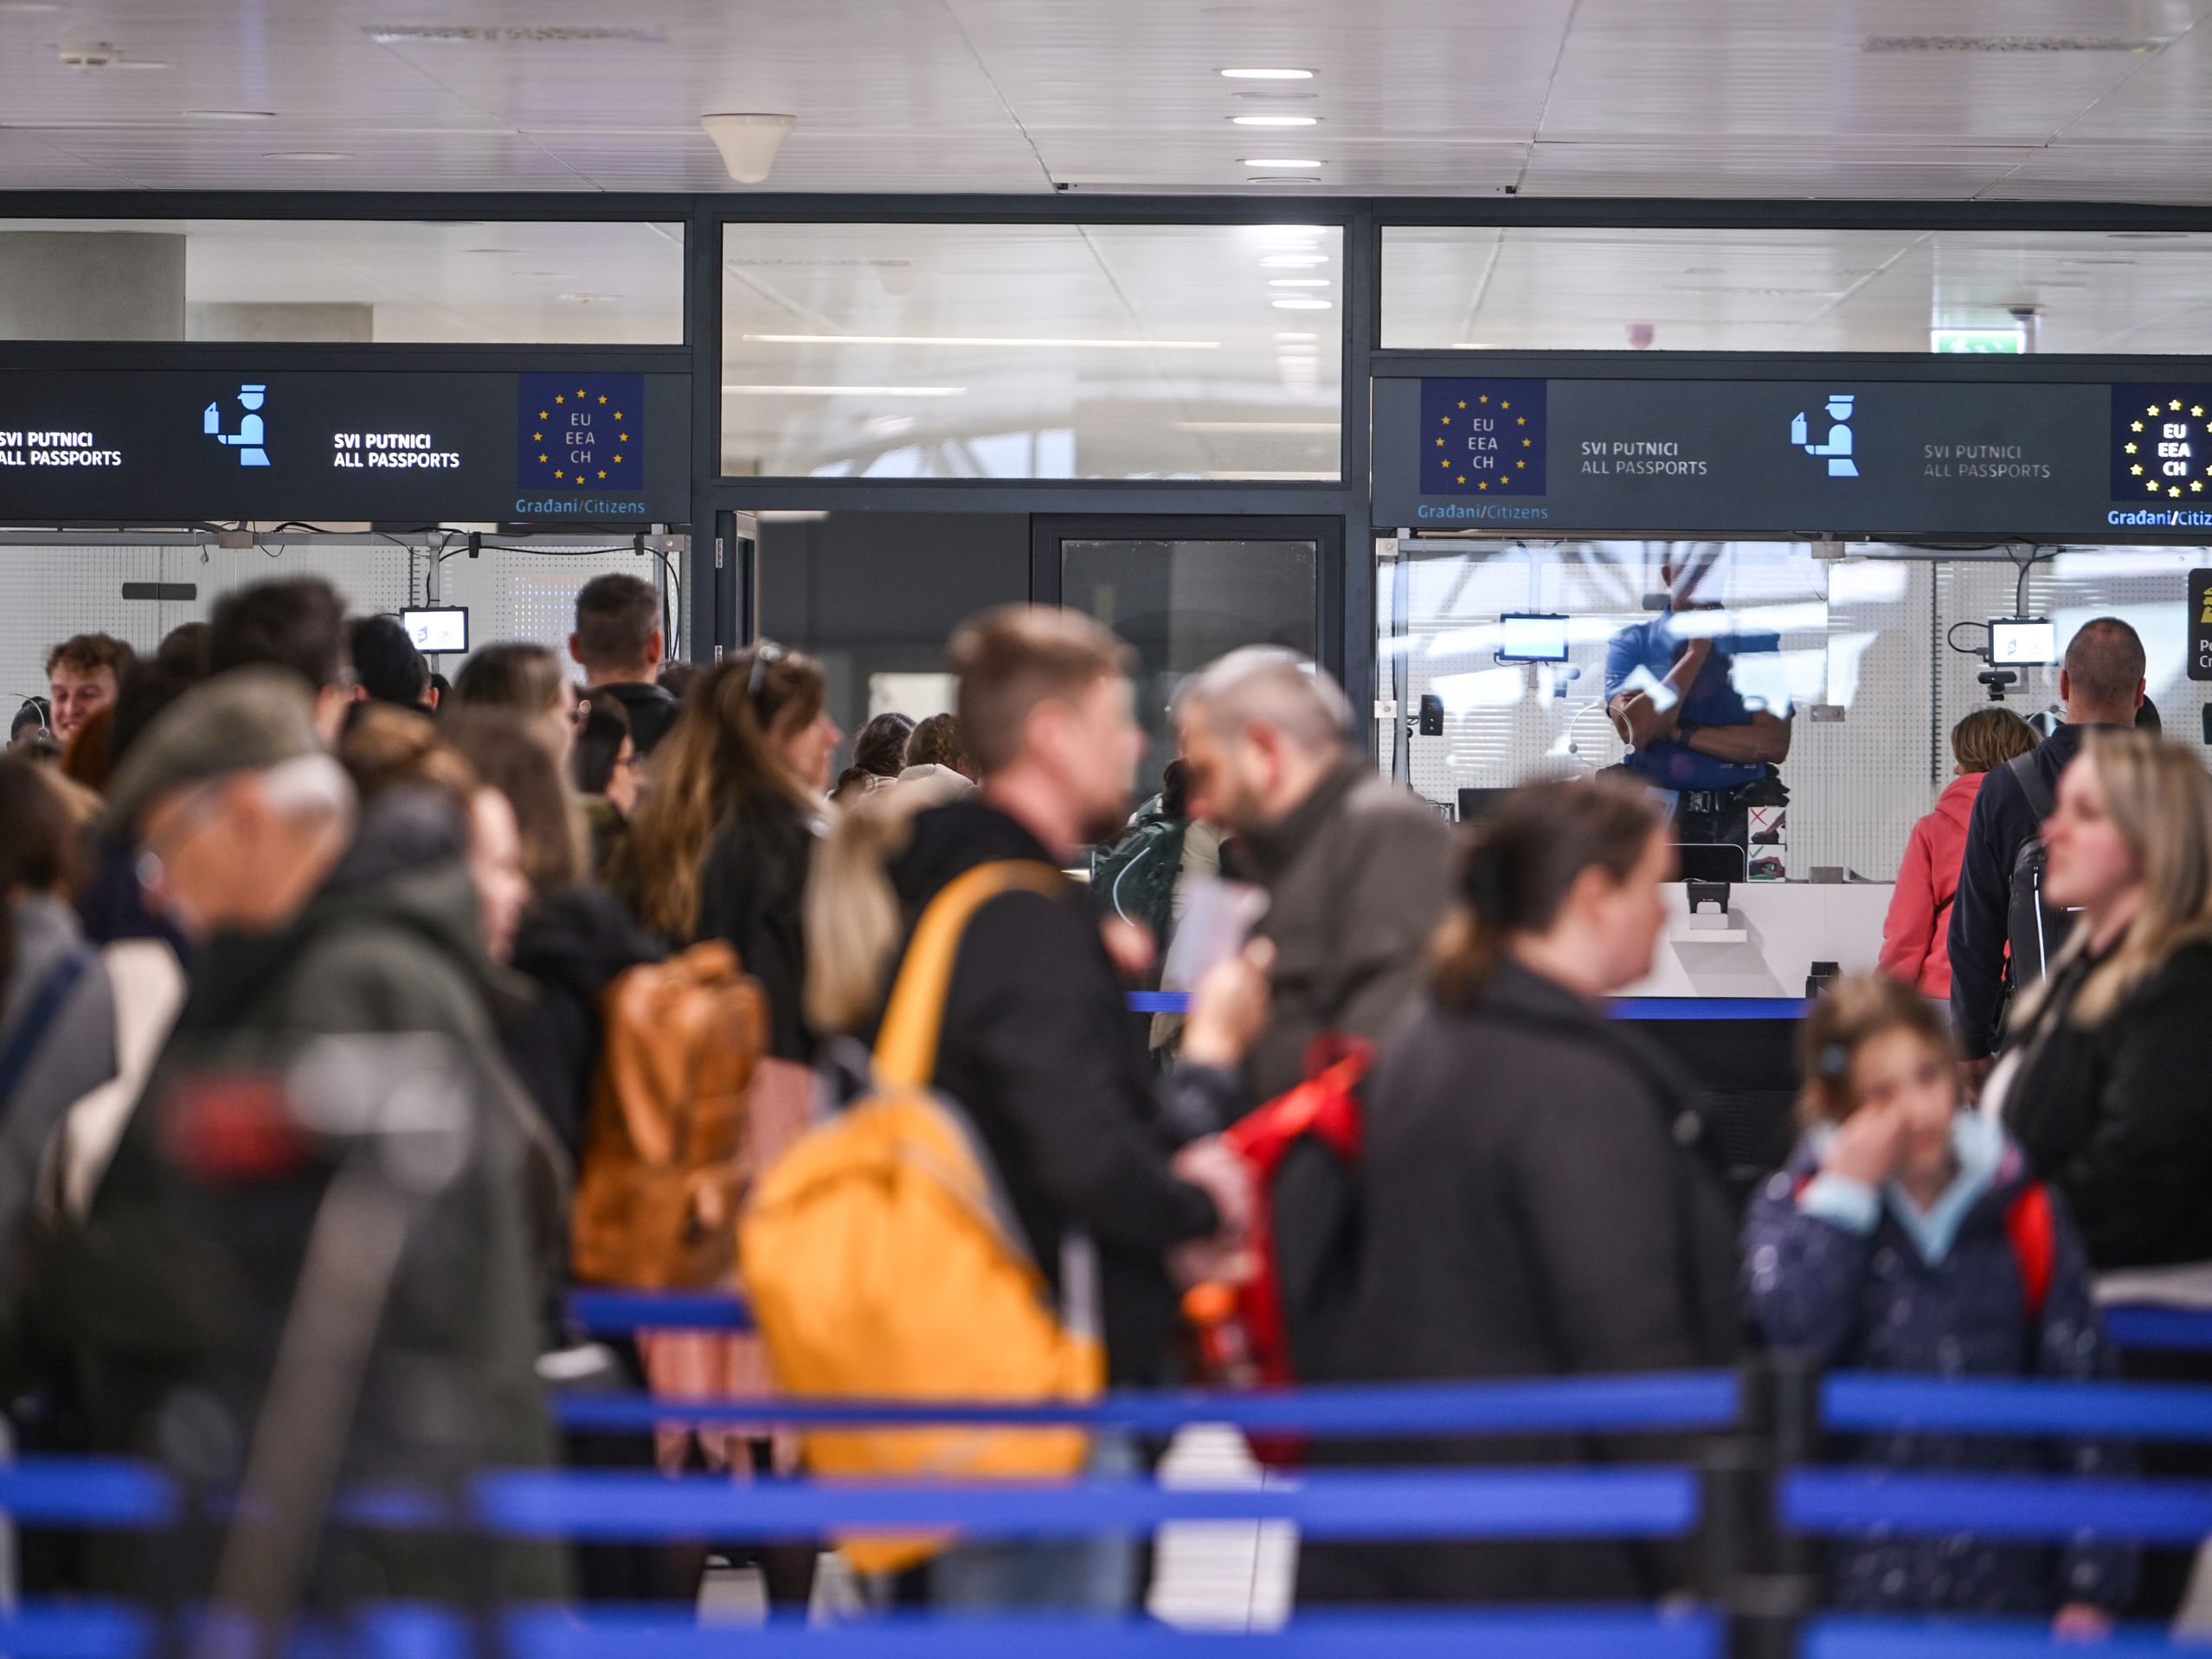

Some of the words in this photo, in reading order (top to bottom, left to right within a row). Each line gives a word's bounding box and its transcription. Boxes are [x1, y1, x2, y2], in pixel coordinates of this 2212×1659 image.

[571, 413, 591, 427] EU
[1473, 418, 1494, 432] EU
[566, 432, 595, 445] EEA
[2163, 423, 2187, 439] EU
[0, 432, 23, 447] SVI
[28, 432, 93, 447] PUTNICI
[334, 434, 360, 448] SVI
[365, 434, 431, 448] PUTNICI
[1468, 437, 1498, 450] EEA
[1582, 441, 1606, 455] SVI
[1613, 442, 1678, 456] PUTNICI
[1924, 444, 1949, 459] SVI
[1956, 445, 2021, 459] PUTNICI
[2157, 442, 2191, 458] EEA
[0, 450, 26, 466] ALL
[30, 451, 122, 466] PASSPORTS
[333, 452, 364, 467] ALL
[368, 453, 460, 468] PASSPORTS
[570, 451, 591, 464] CH
[1473, 456, 1494, 469] CH
[1581, 460, 1610, 474] ALL
[1616, 461, 1707, 475] PASSPORTS
[1924, 464, 1952, 477] ALL
[1958, 464, 2050, 478] PASSPORTS
[2163, 461, 2187, 476] CH
[516, 498, 645, 513] Građani/Citizens
[1418, 504, 1548, 519] Građani/Citizens
